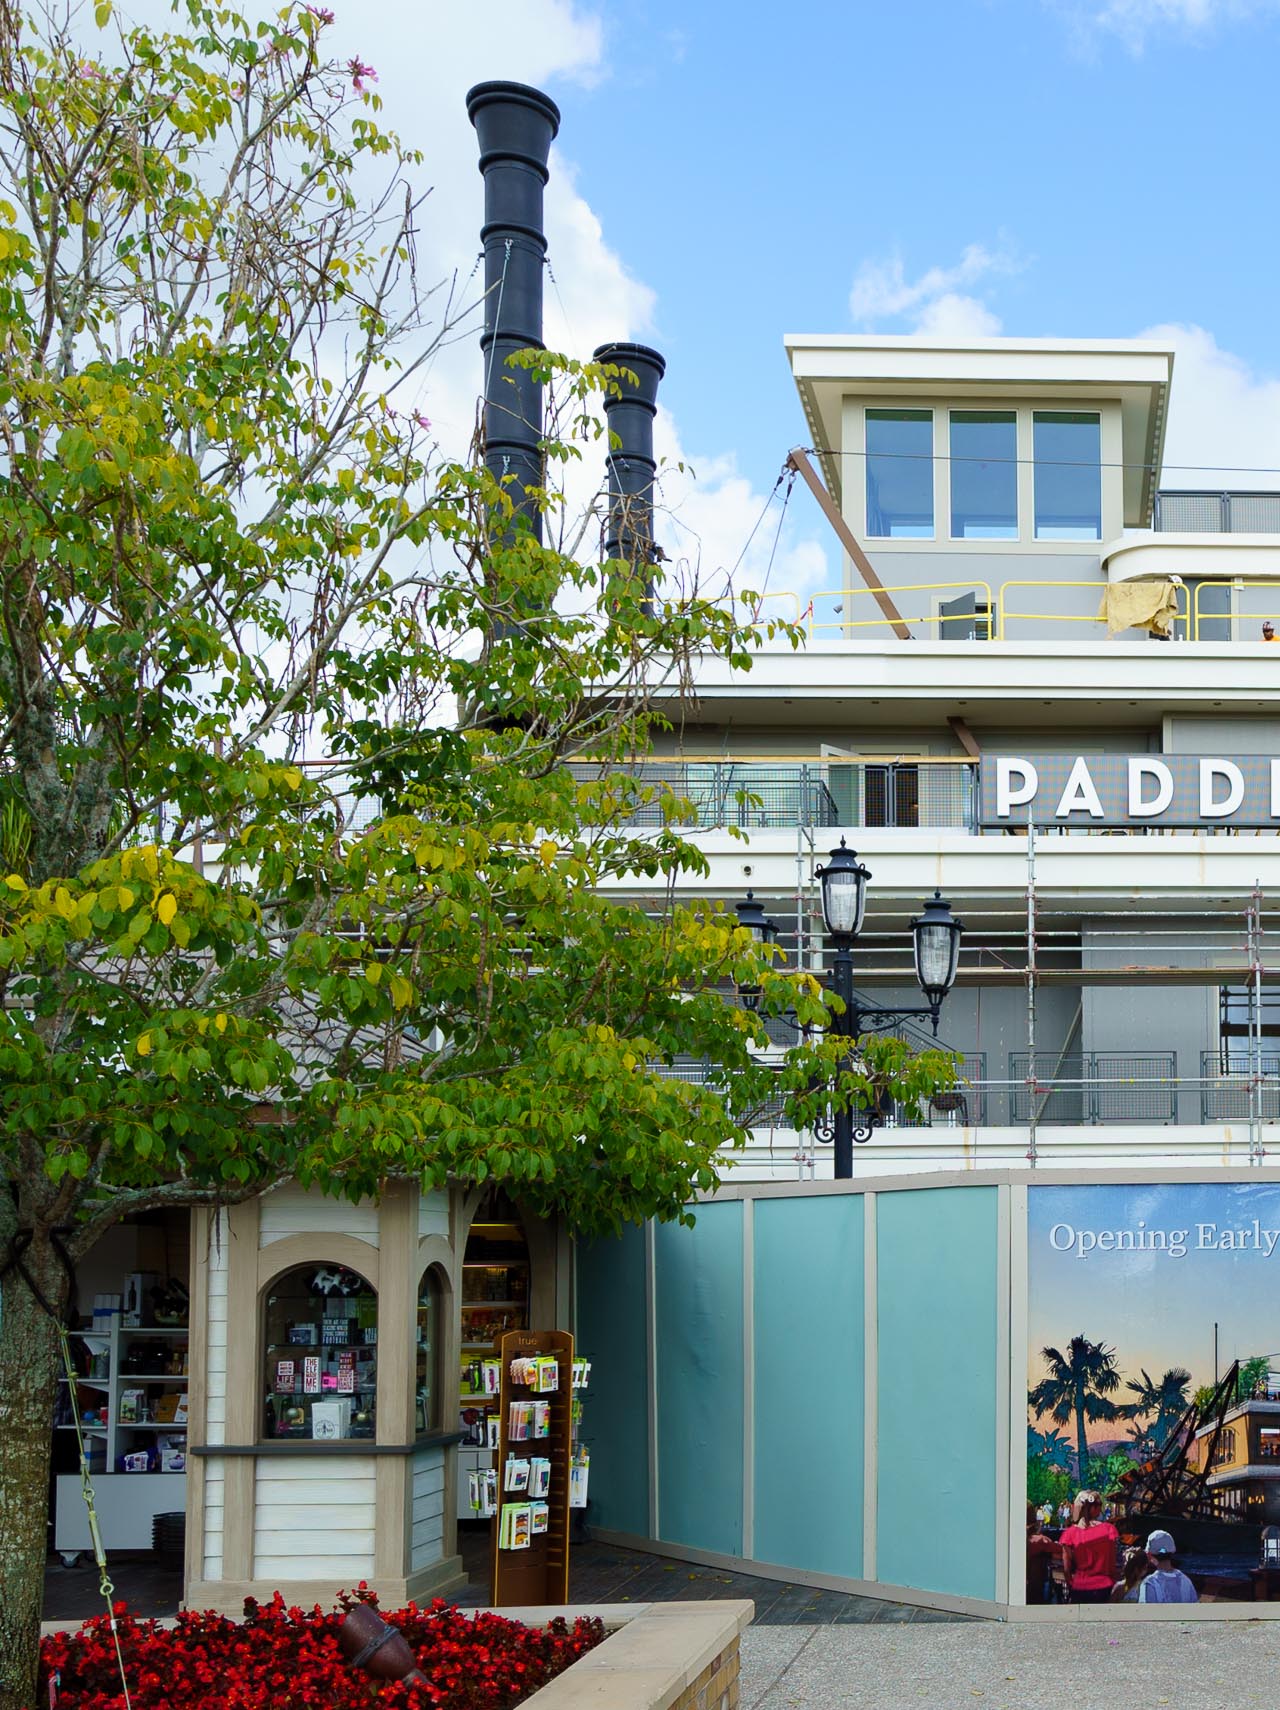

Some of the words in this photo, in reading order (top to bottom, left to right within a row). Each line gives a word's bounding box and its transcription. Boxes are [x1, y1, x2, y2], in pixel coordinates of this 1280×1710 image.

[1049, 1221, 1188, 1258] Opening
[306, 1358, 317, 1366] THE
[306, 1365, 317, 1373] ELF
[277, 1375, 294, 1383] LIFE
